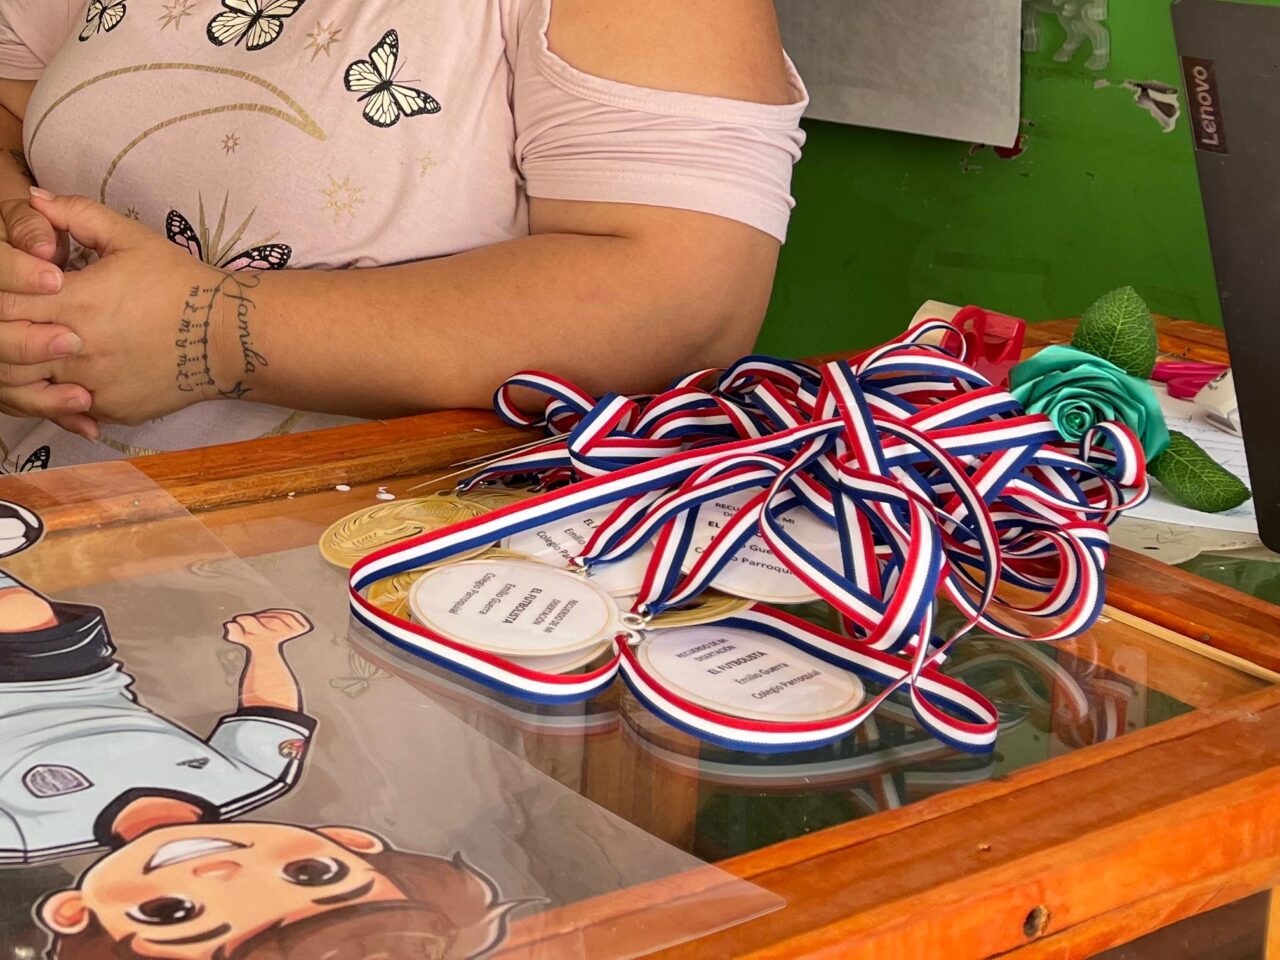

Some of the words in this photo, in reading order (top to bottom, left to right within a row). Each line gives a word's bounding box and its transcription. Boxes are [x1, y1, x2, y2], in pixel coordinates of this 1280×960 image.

[1193, 65, 1219, 145] Lenovo
[535, 529, 562, 551] Colegio
[472, 571, 497, 592] Colegio
[494, 582, 517, 600] Emilio
[532, 587, 544, 596] EL
[447, 589, 480, 616] Parroquial
[477, 597, 503, 616] Guerra
[501, 591, 537, 625] FUTBOLISTA
[555, 598, 579, 623] RECUERDO
[675, 642, 712, 659] RECUERDO
[706, 666, 721, 676] EL
[719, 650, 769, 673] FUTBOLISTA
[734, 672, 763, 686] Emilio
[760, 662, 790, 678] Guerra
[751, 682, 784, 701] Colegio
[781, 669, 823, 692] Parroquial
